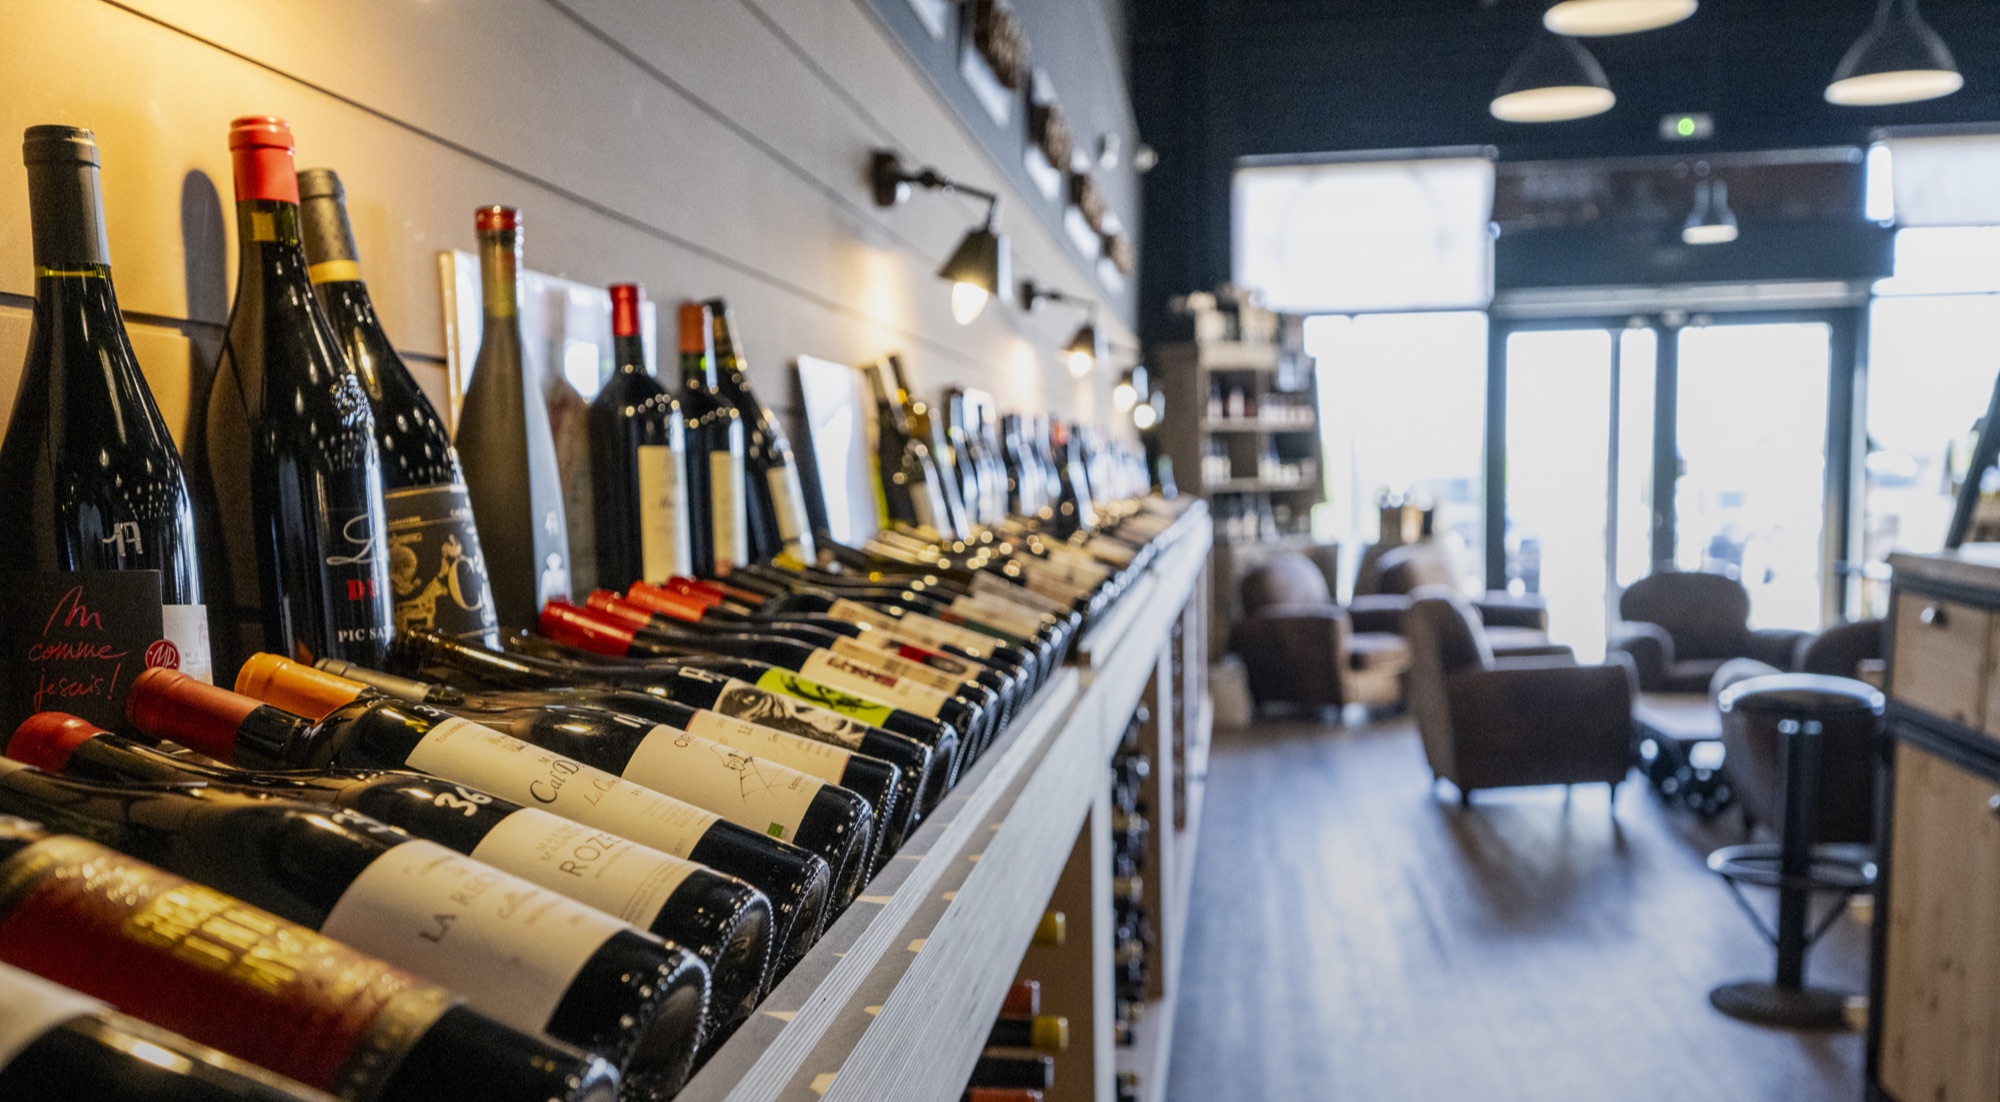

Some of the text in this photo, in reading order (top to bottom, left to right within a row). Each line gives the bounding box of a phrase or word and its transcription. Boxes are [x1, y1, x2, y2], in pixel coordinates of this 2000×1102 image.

[337, 629, 366, 643] PIC
[28, 639, 128, 662] comme
[434, 785, 494, 817] 36
